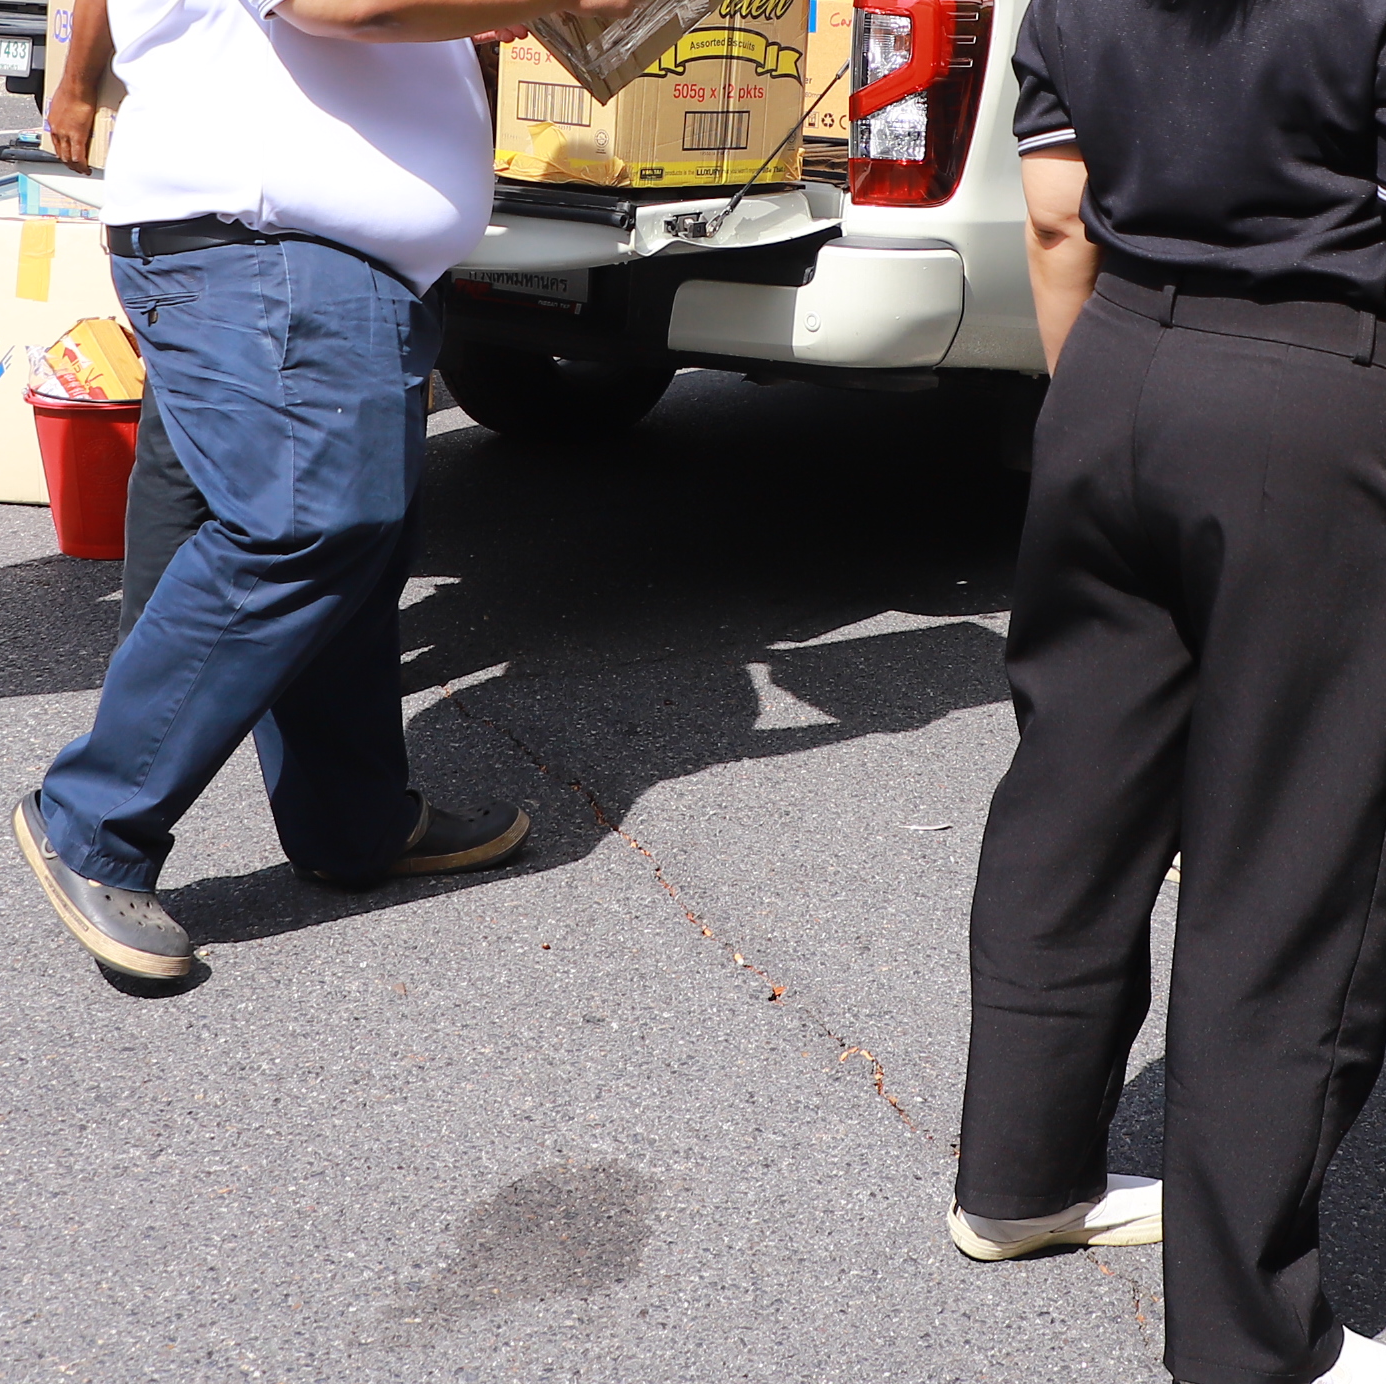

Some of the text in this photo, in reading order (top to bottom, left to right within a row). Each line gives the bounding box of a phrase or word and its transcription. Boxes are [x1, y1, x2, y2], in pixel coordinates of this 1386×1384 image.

[690, 37, 725, 50] Assorted
[511, 46, 553, 64] 505g x
[673, 83, 705, 102] 505g
[710, 87, 717, 98] x
[738, 84, 764, 102] pkts
